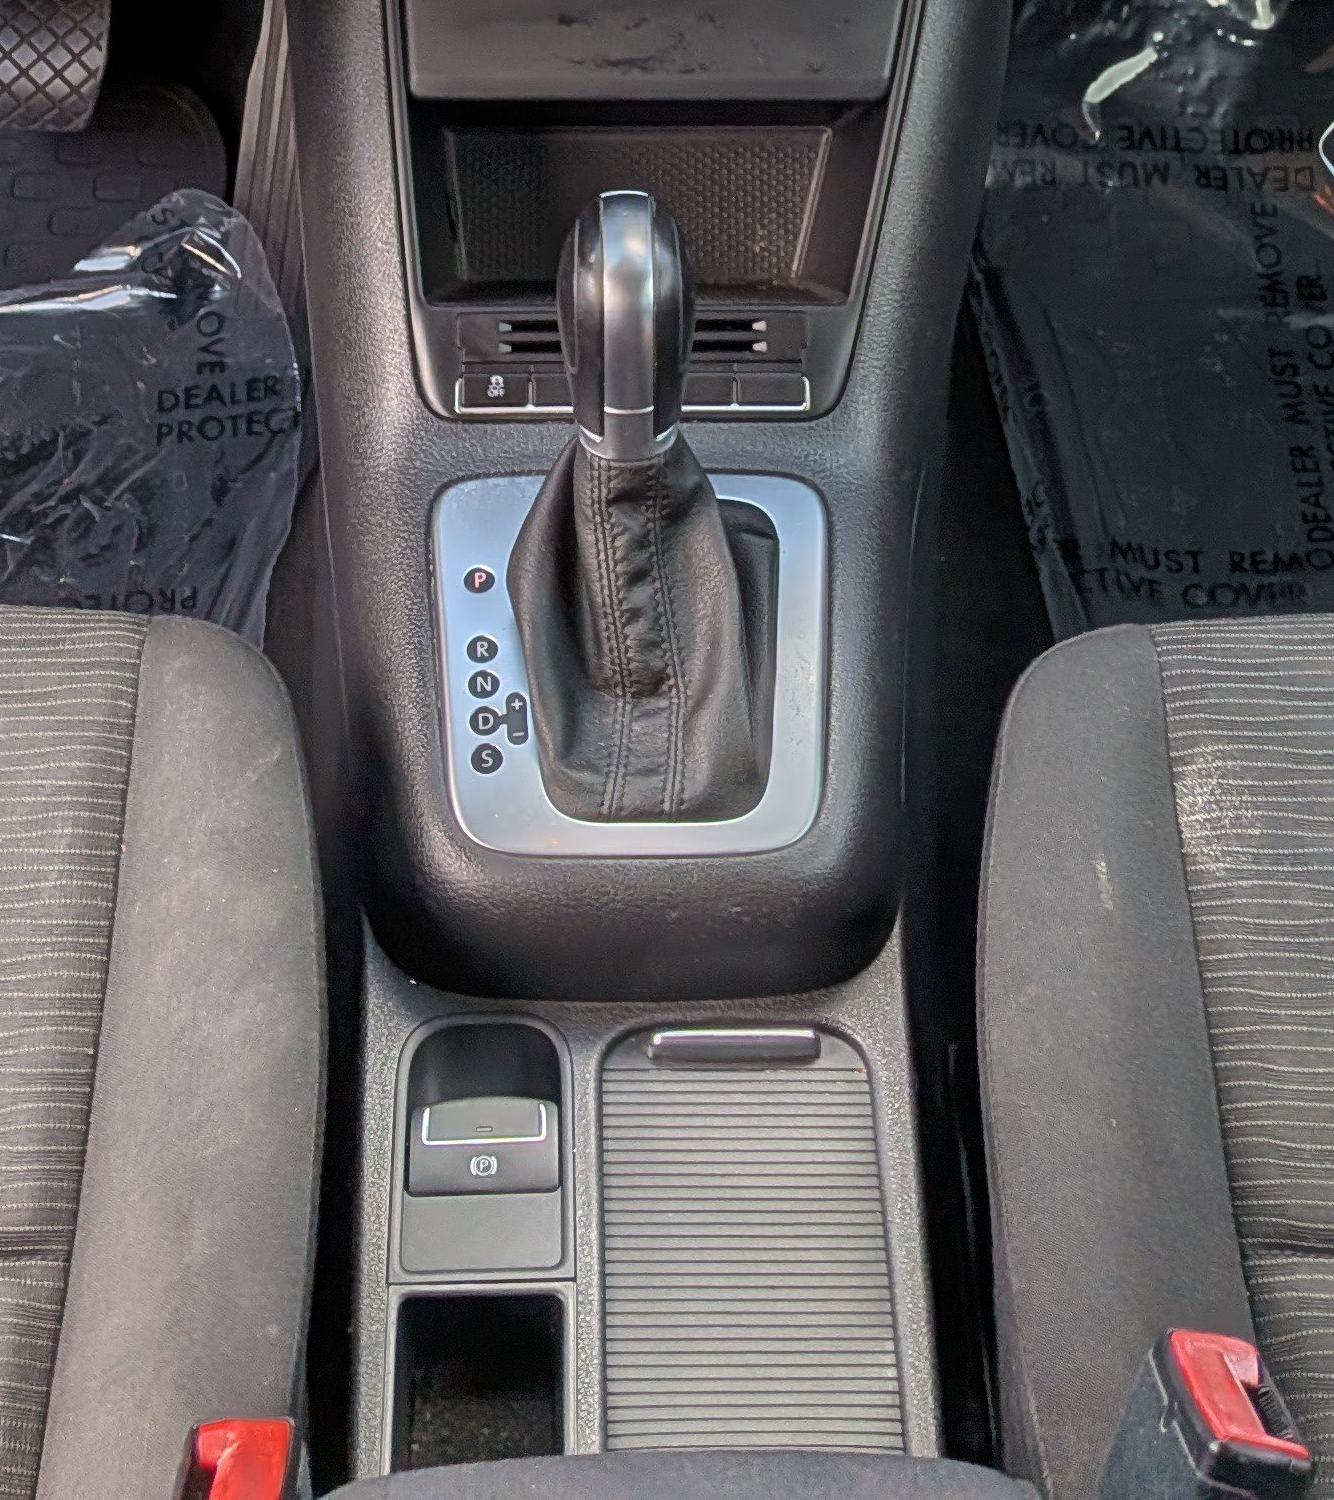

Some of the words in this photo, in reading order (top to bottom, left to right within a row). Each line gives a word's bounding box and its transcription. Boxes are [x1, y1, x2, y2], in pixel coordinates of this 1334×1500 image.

[1080, 161, 1172, 187] MUST
[1195, 163, 1314, 193] DEALER
[156, 375, 280, 414] DEALER
[1267, 347, 1311, 426] MUST
[474, 572, 487, 588] P
[476, 641, 489, 657] R
[476, 676, 492, 692] N
[478, 713, 494, 730] D
[481, 750, 494, 767] S
